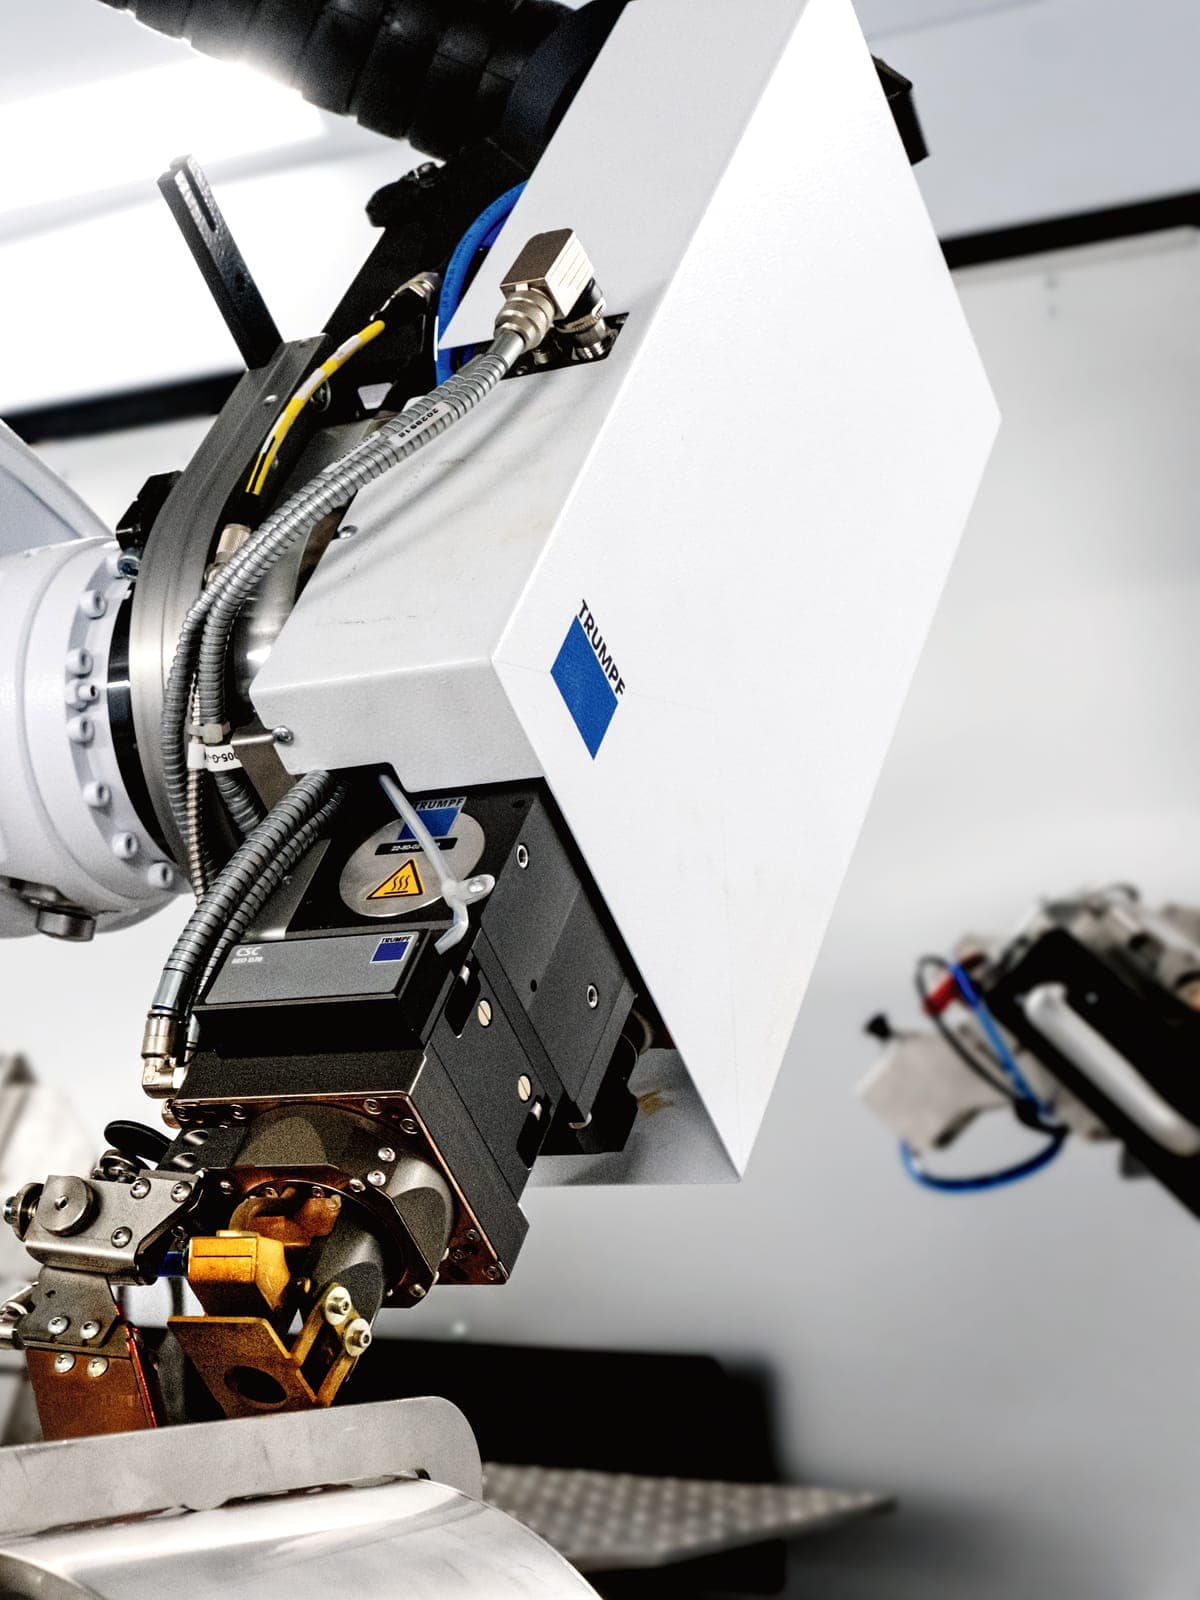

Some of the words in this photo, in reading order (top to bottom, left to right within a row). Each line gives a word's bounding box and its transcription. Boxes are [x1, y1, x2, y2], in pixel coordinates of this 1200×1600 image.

[578, 599, 625, 696] TRUMPF
[414, 798, 464, 811] TRUMPF
[381, 936, 412, 944] TRUMPF
[236, 946, 261, 956] CSC
